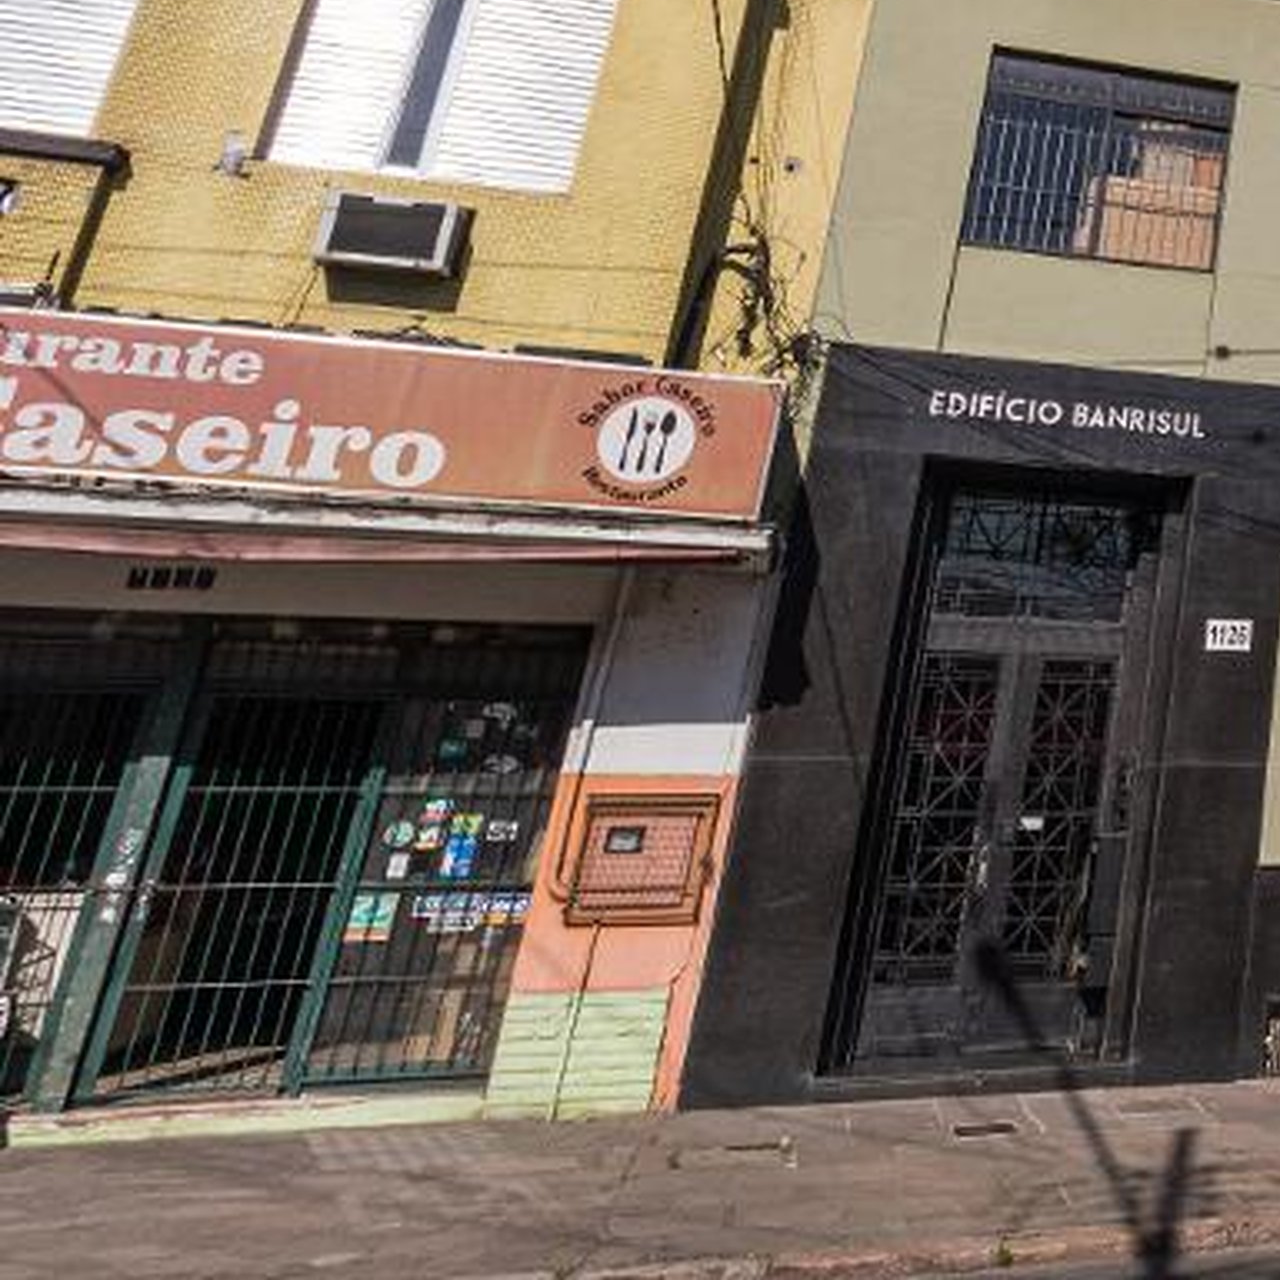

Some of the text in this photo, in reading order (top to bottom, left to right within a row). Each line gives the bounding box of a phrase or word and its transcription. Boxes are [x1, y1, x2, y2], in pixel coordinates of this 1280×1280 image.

[0, 375, 447, 488] aseiro
[578, 375, 716, 438] Sabor Caseiro
[927, 389, 1206, 439] EDIFÍCIO BANRISUL
